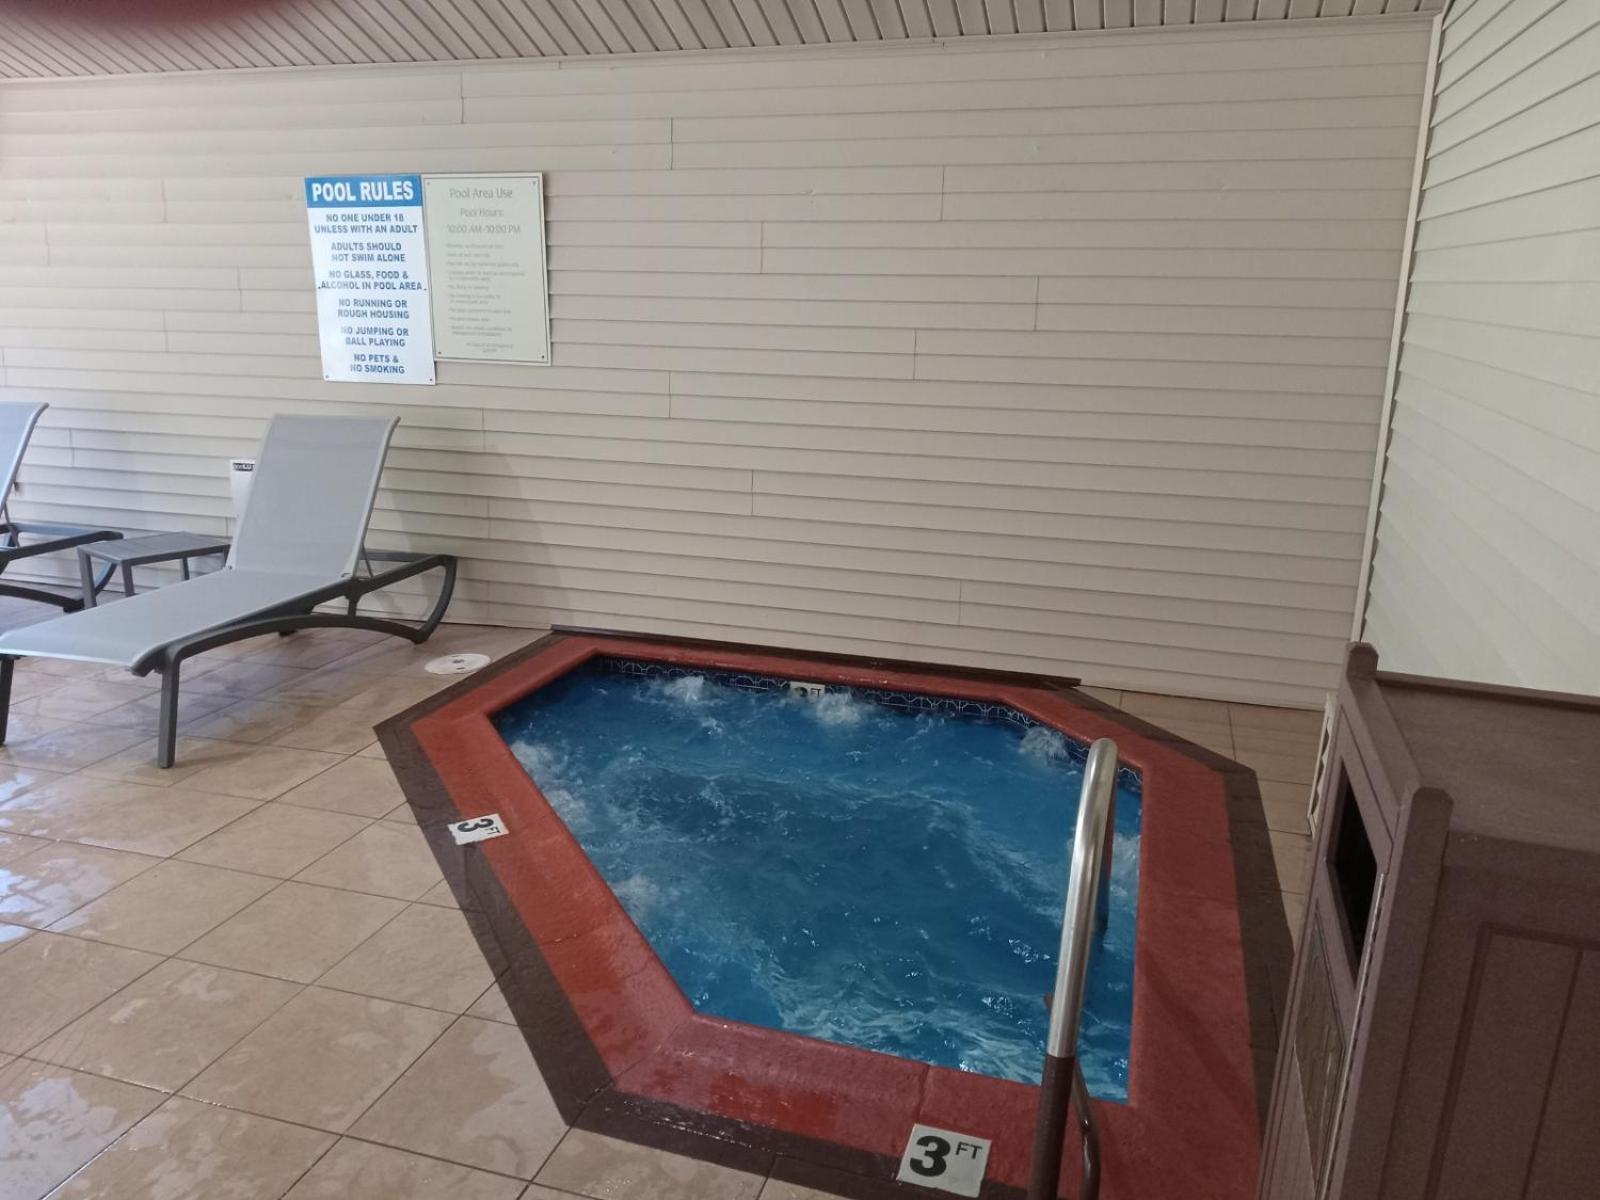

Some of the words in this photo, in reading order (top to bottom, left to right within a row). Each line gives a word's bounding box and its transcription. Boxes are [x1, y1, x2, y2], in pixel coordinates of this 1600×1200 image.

[312, 182, 356, 202] POOL
[360, 180, 414, 201] RULES
[449, 187, 470, 199] Pool
[472, 188, 494, 199] Area
[496, 188, 513, 198] Use
[326, 214, 338, 222] NO
[341, 214, 358, 222] ONE
[361, 214, 392, 222] UNDER
[314, 225, 348, 234] UNLESS
[350, 225, 372, 233] WITH
[375, 225, 388, 233] AN
[390, 224, 418, 233] ADULT
[331, 242, 364, 251] ADULTS
[366, 242, 402, 251] SHOULD
[331, 254, 349, 262] NOT
[351, 254, 374, 262] SWIM
[376, 254, 406, 262] ALONE
[329, 270, 341, 279] NO
[344, 270, 374, 280] GLASS,
[376, 270, 400, 279] FOOD
[402, 270, 409, 279] &
[321, 281, 360, 290] ALCOHOL
[362, 282, 372, 290] IN
[374, 282, 397, 290] POOL
[400, 282, 423, 290] AREA
[338, 298, 351, 307] NO
[353, 299, 392, 308] RUNNING
[394, 300, 408, 308] OR
[337, 309, 368, 318] ROUGH
[370, 310, 410, 320] HOUSING
[341, 326, 353, 335] NO
[356, 326, 394, 336] JUMPING
[396, 328, 409, 336] OR
[346, 338, 367, 346] BALL
[368, 338, 406, 348] PLAYING
[354, 354, 366, 362] NO
[368, 354, 390, 363] PETS
[392, 355, 400, 363] &
[350, 364, 363, 373] NO
[364, 364, 406, 374] SMOKING
[457, 818, 494, 833] 3
[484, 826, 502, 836] FT
[909, 1135, 951, 1178] 3
[955, 1142, 983, 1160] FT
